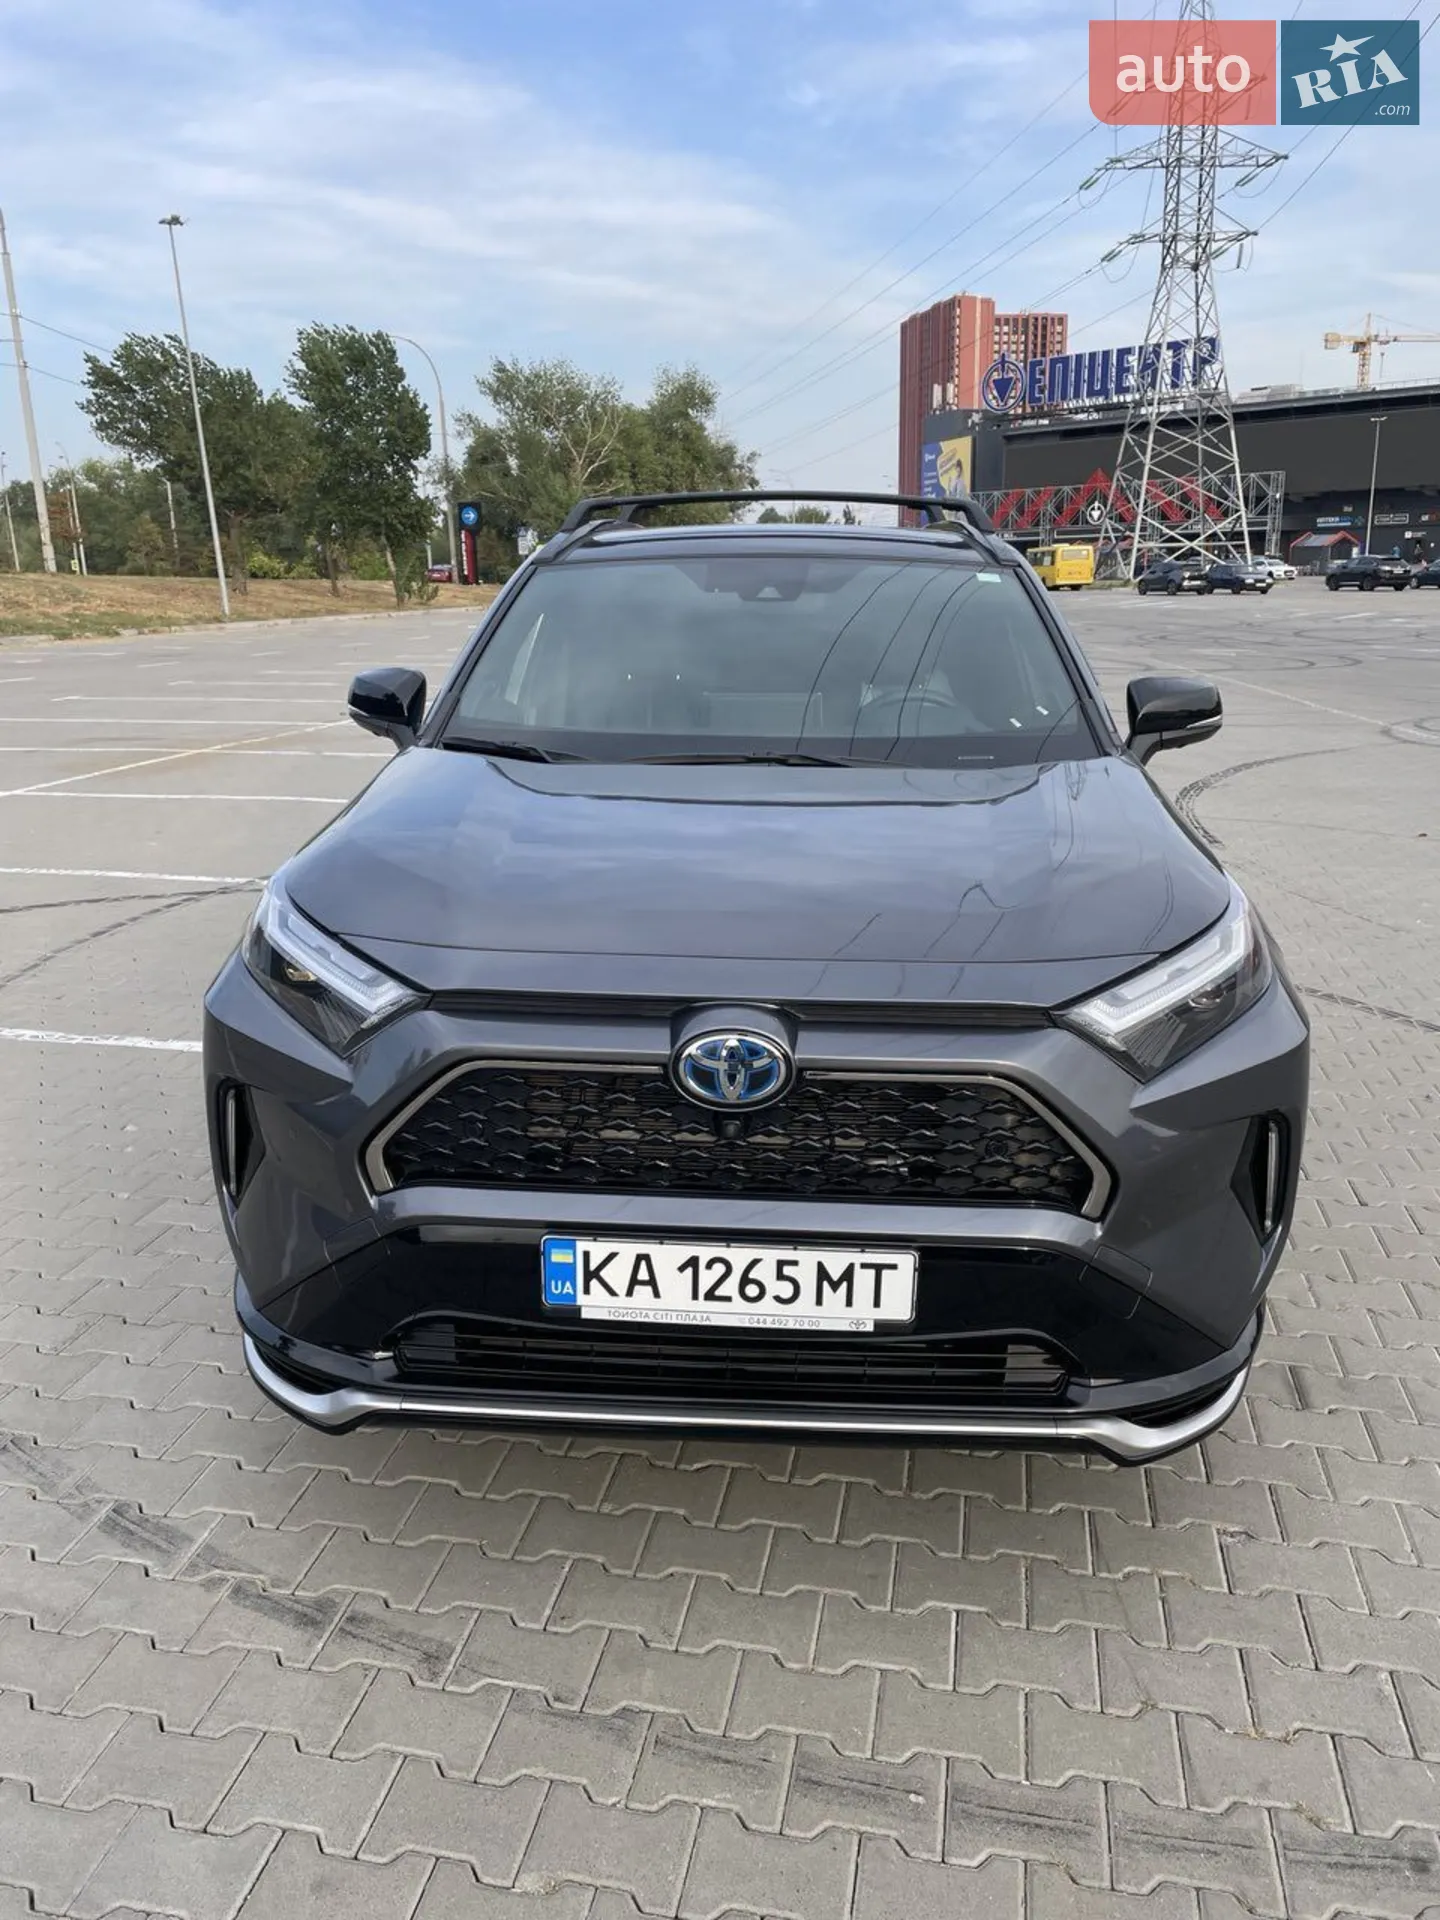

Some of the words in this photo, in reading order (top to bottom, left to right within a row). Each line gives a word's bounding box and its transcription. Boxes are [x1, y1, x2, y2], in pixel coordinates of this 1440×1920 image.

[677, 1255, 801, 1305] 1265
[551, 1281, 574, 1295] UA
[748, 1316, 767, 1325] 044
[792, 1318, 805, 1327] 70
[807, 1319, 820, 1328] 00
